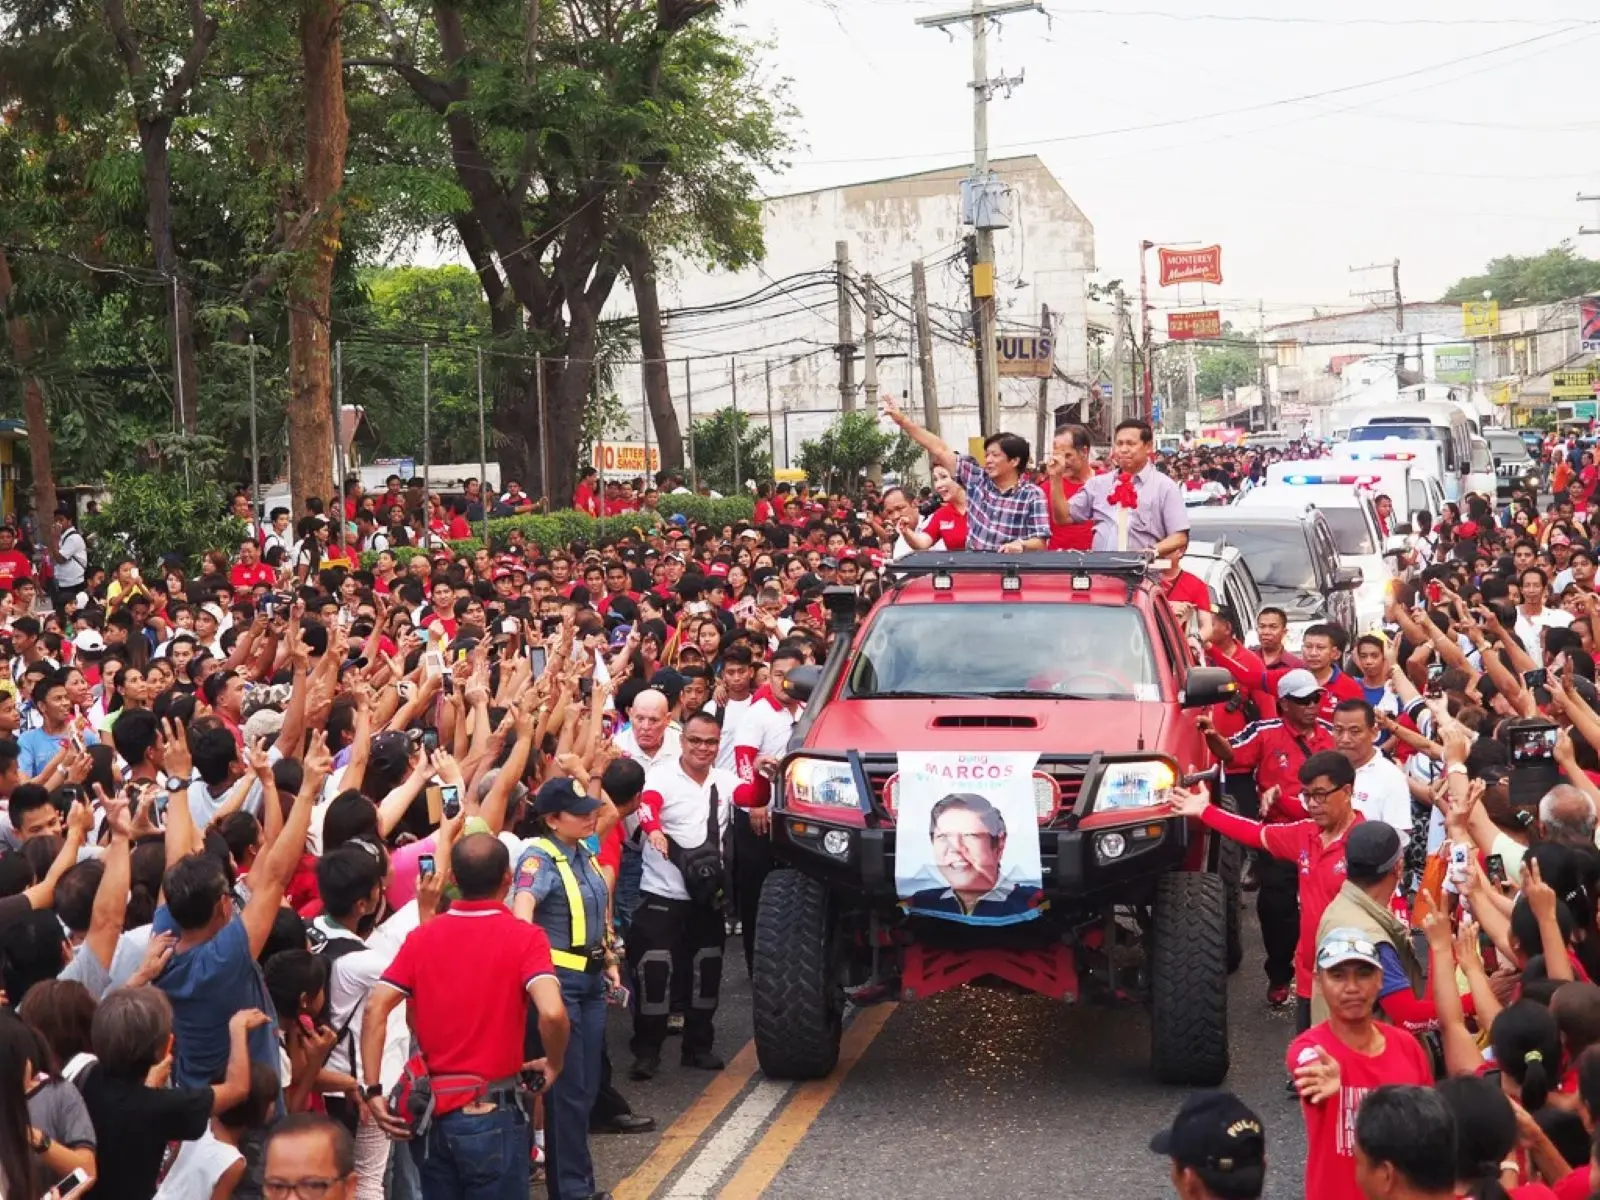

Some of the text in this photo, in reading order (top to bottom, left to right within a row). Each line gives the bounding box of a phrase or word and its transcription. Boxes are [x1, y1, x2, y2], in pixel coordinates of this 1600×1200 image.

[1167, 254, 1212, 265] MONTEREY
[595, 446, 614, 469] NO
[926, 763, 1014, 779] MARCOS
